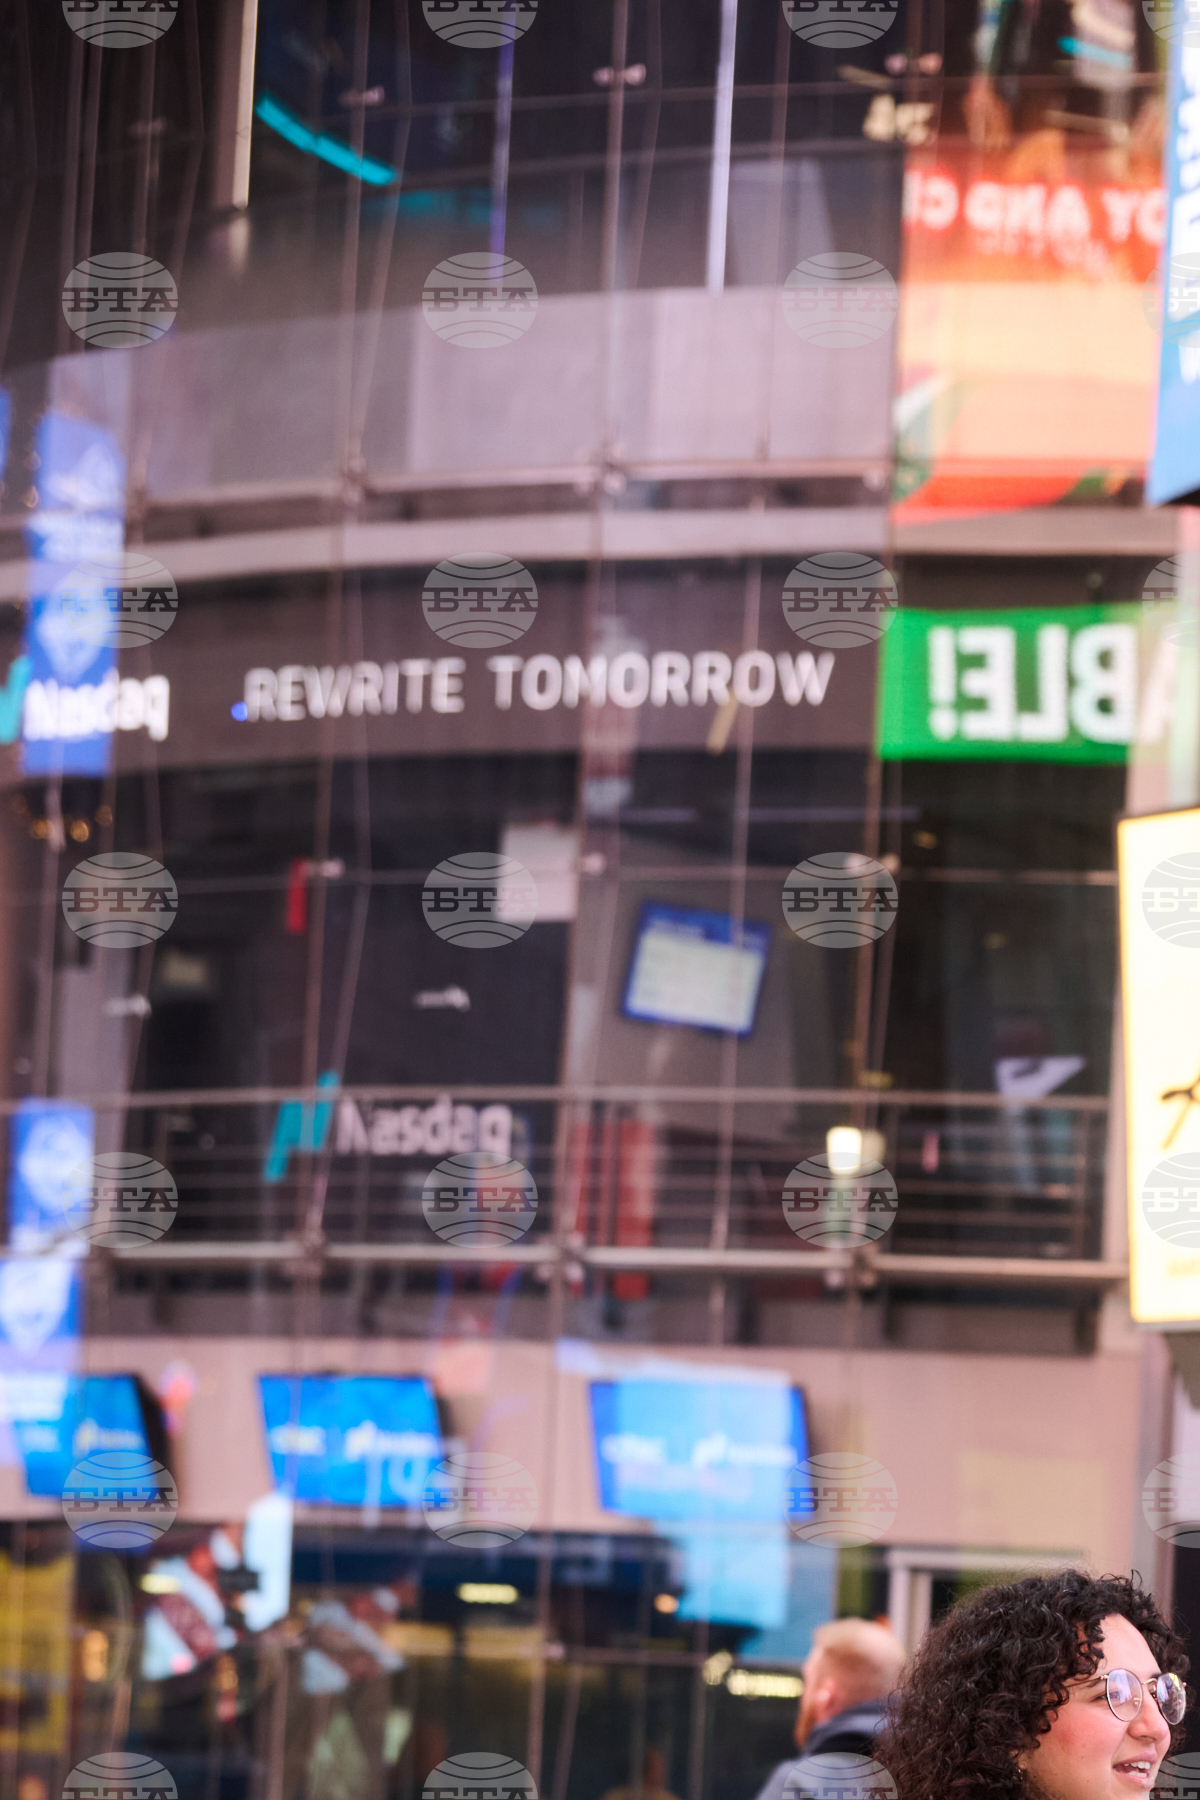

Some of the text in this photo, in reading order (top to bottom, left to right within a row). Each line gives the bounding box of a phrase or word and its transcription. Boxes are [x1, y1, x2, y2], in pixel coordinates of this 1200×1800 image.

[244, 649, 835, 722] REWRITE TOMORROW
[338, 1093, 512, 1157] Nasdaq
